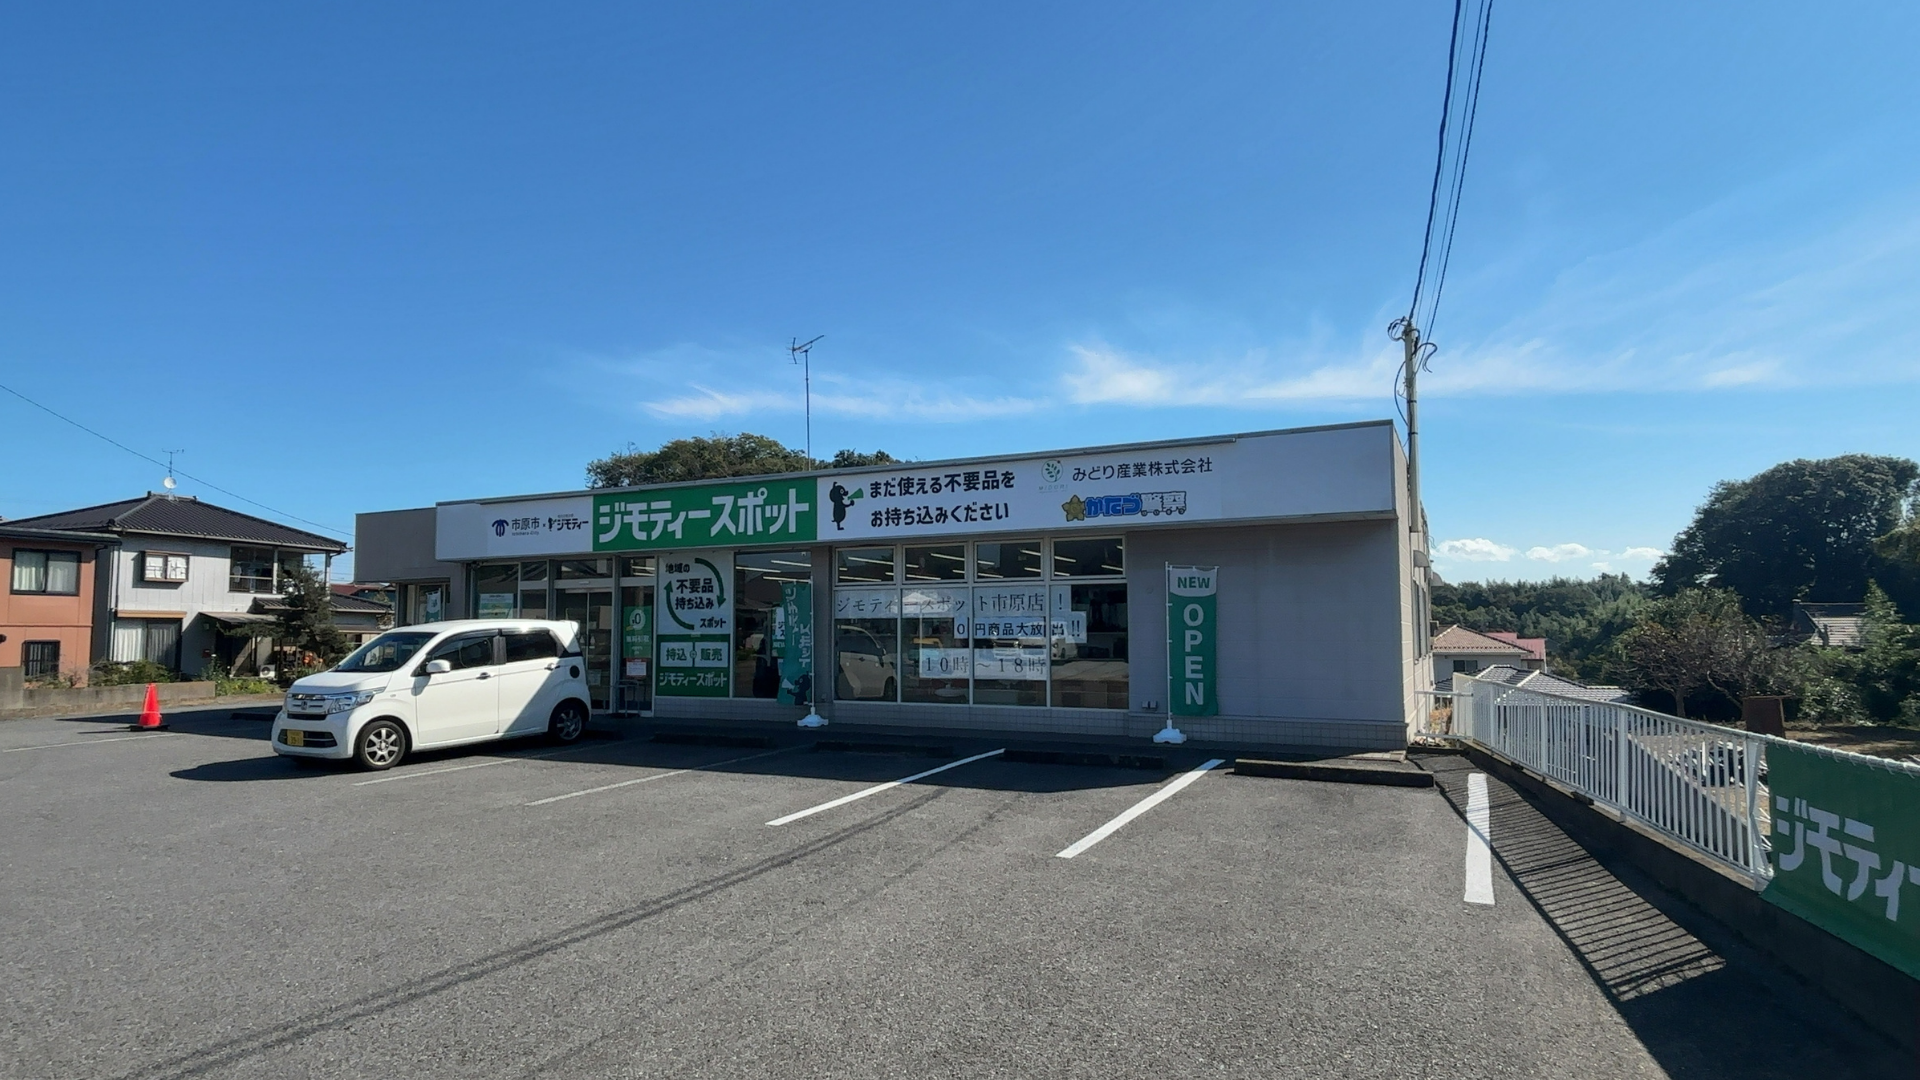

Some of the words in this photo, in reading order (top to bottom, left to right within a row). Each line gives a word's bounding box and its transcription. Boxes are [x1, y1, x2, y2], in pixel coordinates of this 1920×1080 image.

[1072, 457, 1213, 482] みどり産業株式会社
[870, 470, 1015, 499] まだ使える不要品を
[598, 487, 810, 544] ジモティースポット
[870, 501, 1010, 528] お持ち込みください
[511, 517, 540, 531] 市原市
[557, 518, 589, 531] ジモティー
[665, 563, 691, 574] 地域の
[675, 578, 714, 594] 不要品
[1177, 576, 1211, 589] NEW
[675, 596, 715, 610] 持ち込み
[700, 617, 726, 628] スポット
[665, 647, 688, 661] 持込
[700, 647, 723, 661] 販売
[1182, 602, 1205, 706] OPEN
[659, 671, 728, 688] ジモティースポット
